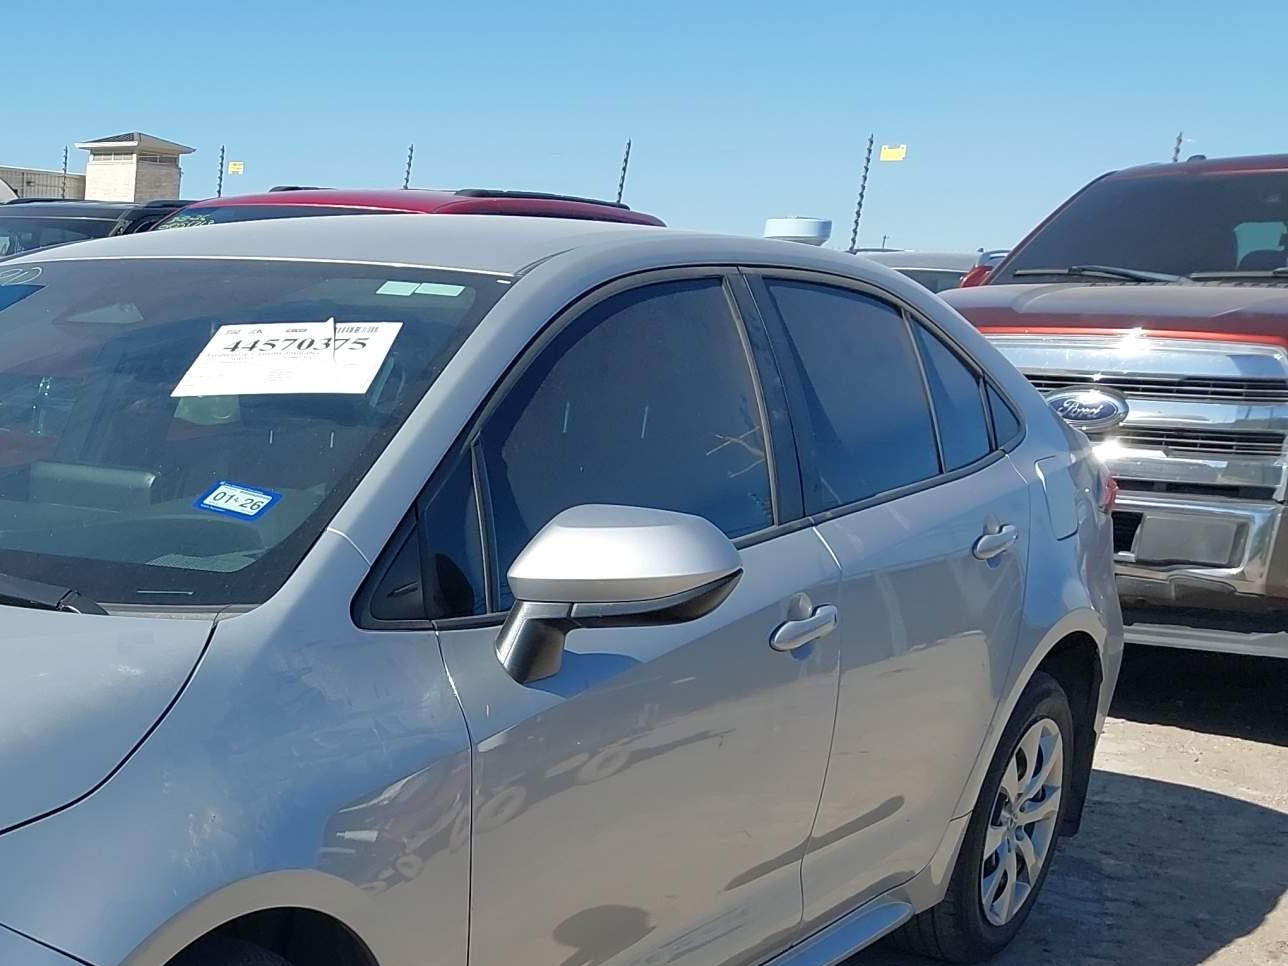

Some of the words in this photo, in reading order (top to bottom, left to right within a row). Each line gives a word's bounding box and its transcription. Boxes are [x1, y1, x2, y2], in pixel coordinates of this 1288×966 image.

[223, 336, 370, 352] 44570375
[1057, 398, 1104, 418] Ford
[212, 491, 236, 504] 01
[238, 498, 265, 511] 26
